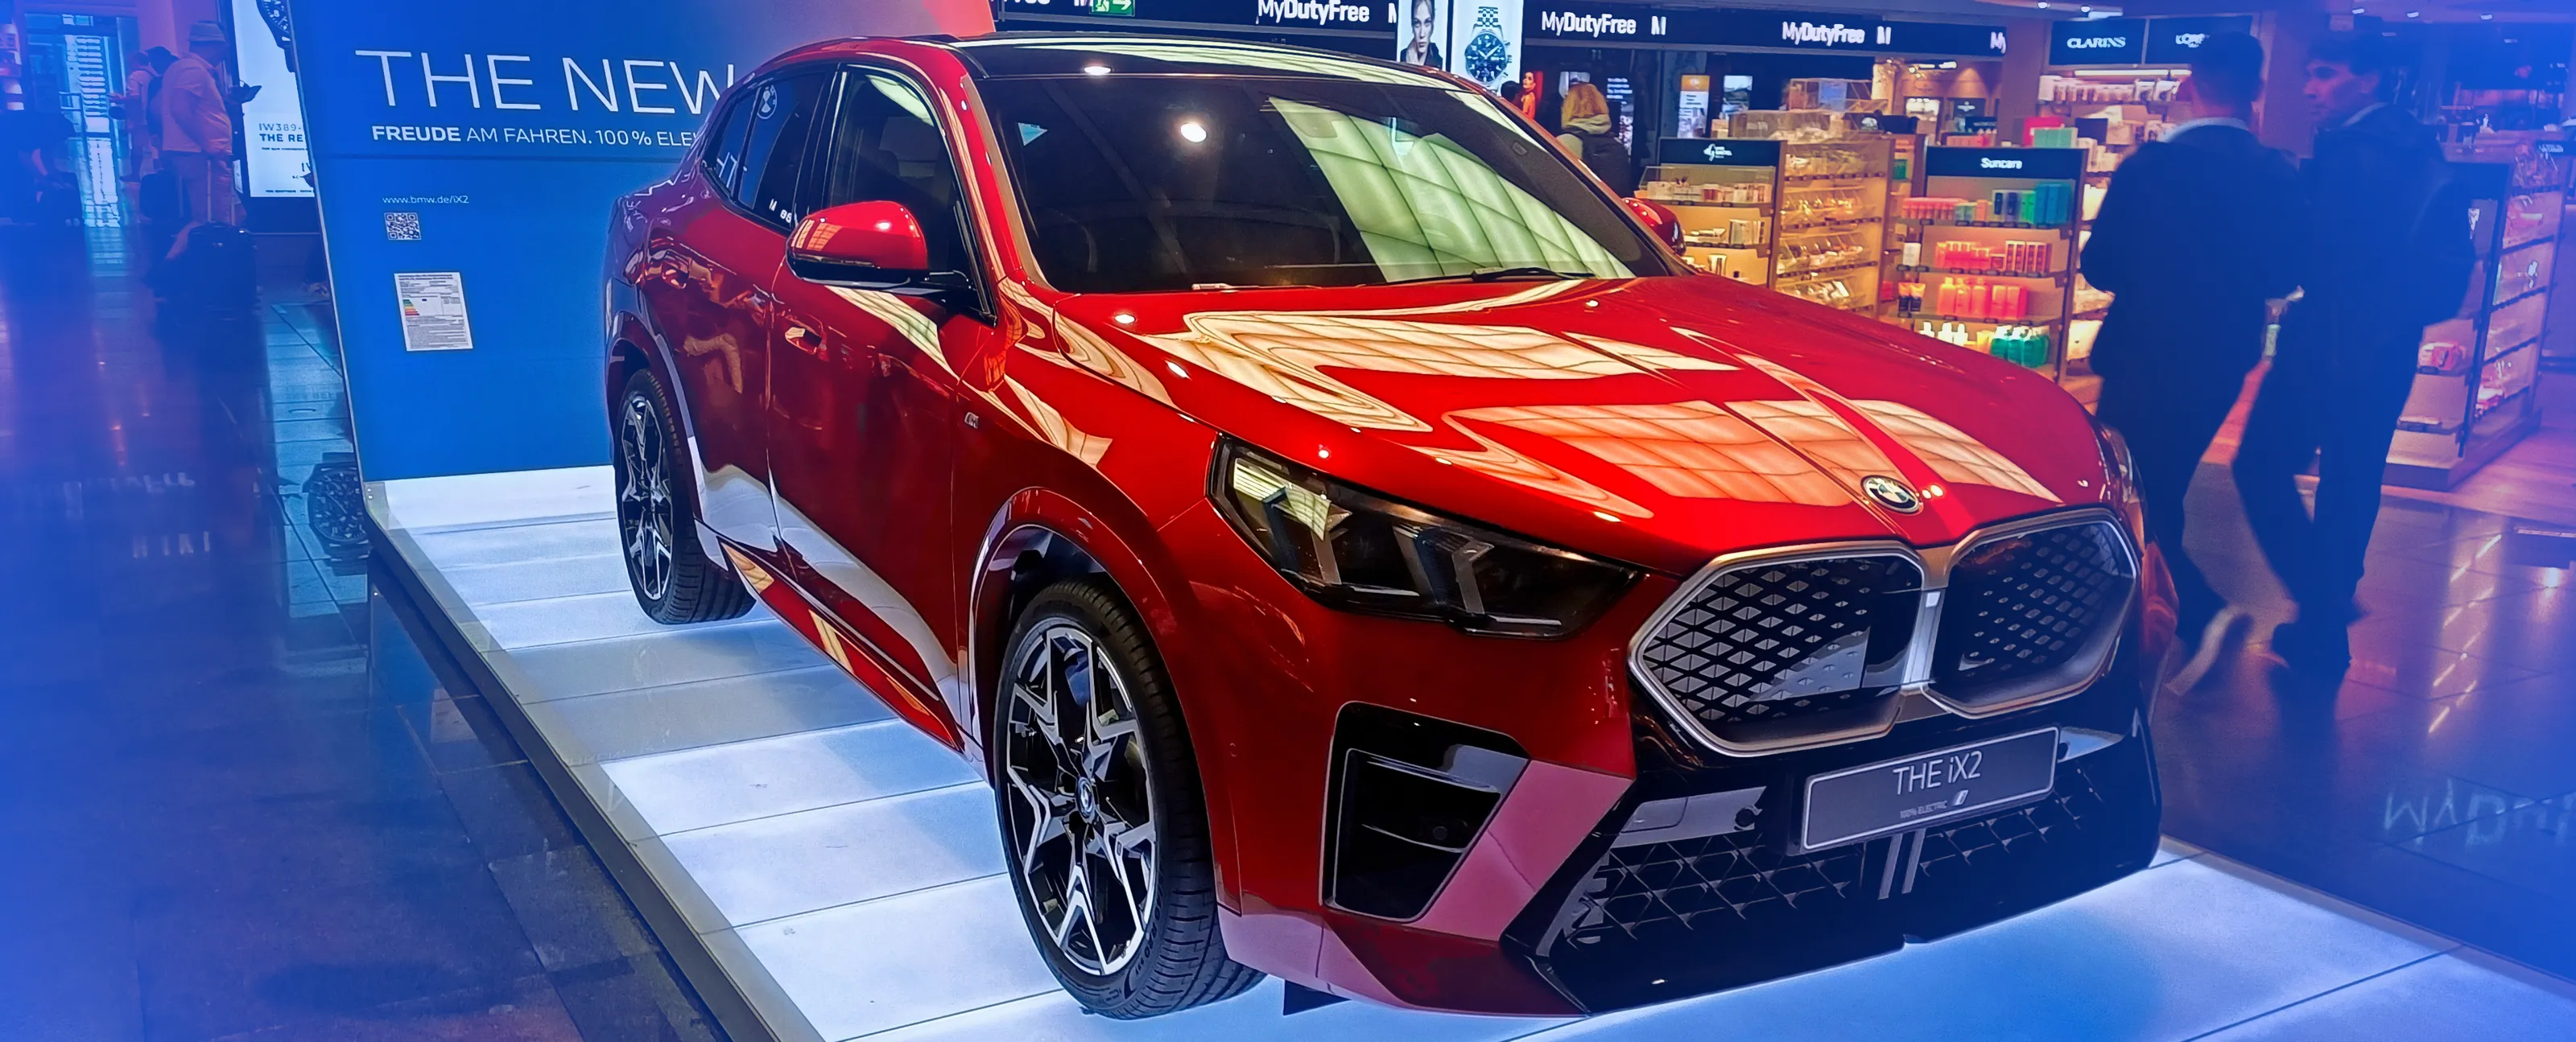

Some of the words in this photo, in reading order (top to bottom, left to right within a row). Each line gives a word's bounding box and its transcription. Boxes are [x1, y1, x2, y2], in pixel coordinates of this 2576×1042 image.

[1257, 0, 1369, 24] MyDutyFree
[1541, 11, 1637, 38] MyDutyFree
[1781, 21, 1865, 47] MyDutyFree
[2066, 36, 2126, 49] CLARINS
[355, 50, 541, 110] THE
[562, 57, 734, 114] NEW
[258, 134, 276, 142] THE
[372, 126, 461, 142] FREUDE
[466, 127, 497, 142] AM
[504, 128, 592, 145] FAHREN.
[1980, 157, 2022, 170] Suncare
[382, 195, 469, 204] www.bmw.de/iX2
[1893, 759, 1943, 795] THE
[1947, 751, 1982, 784] iX2
